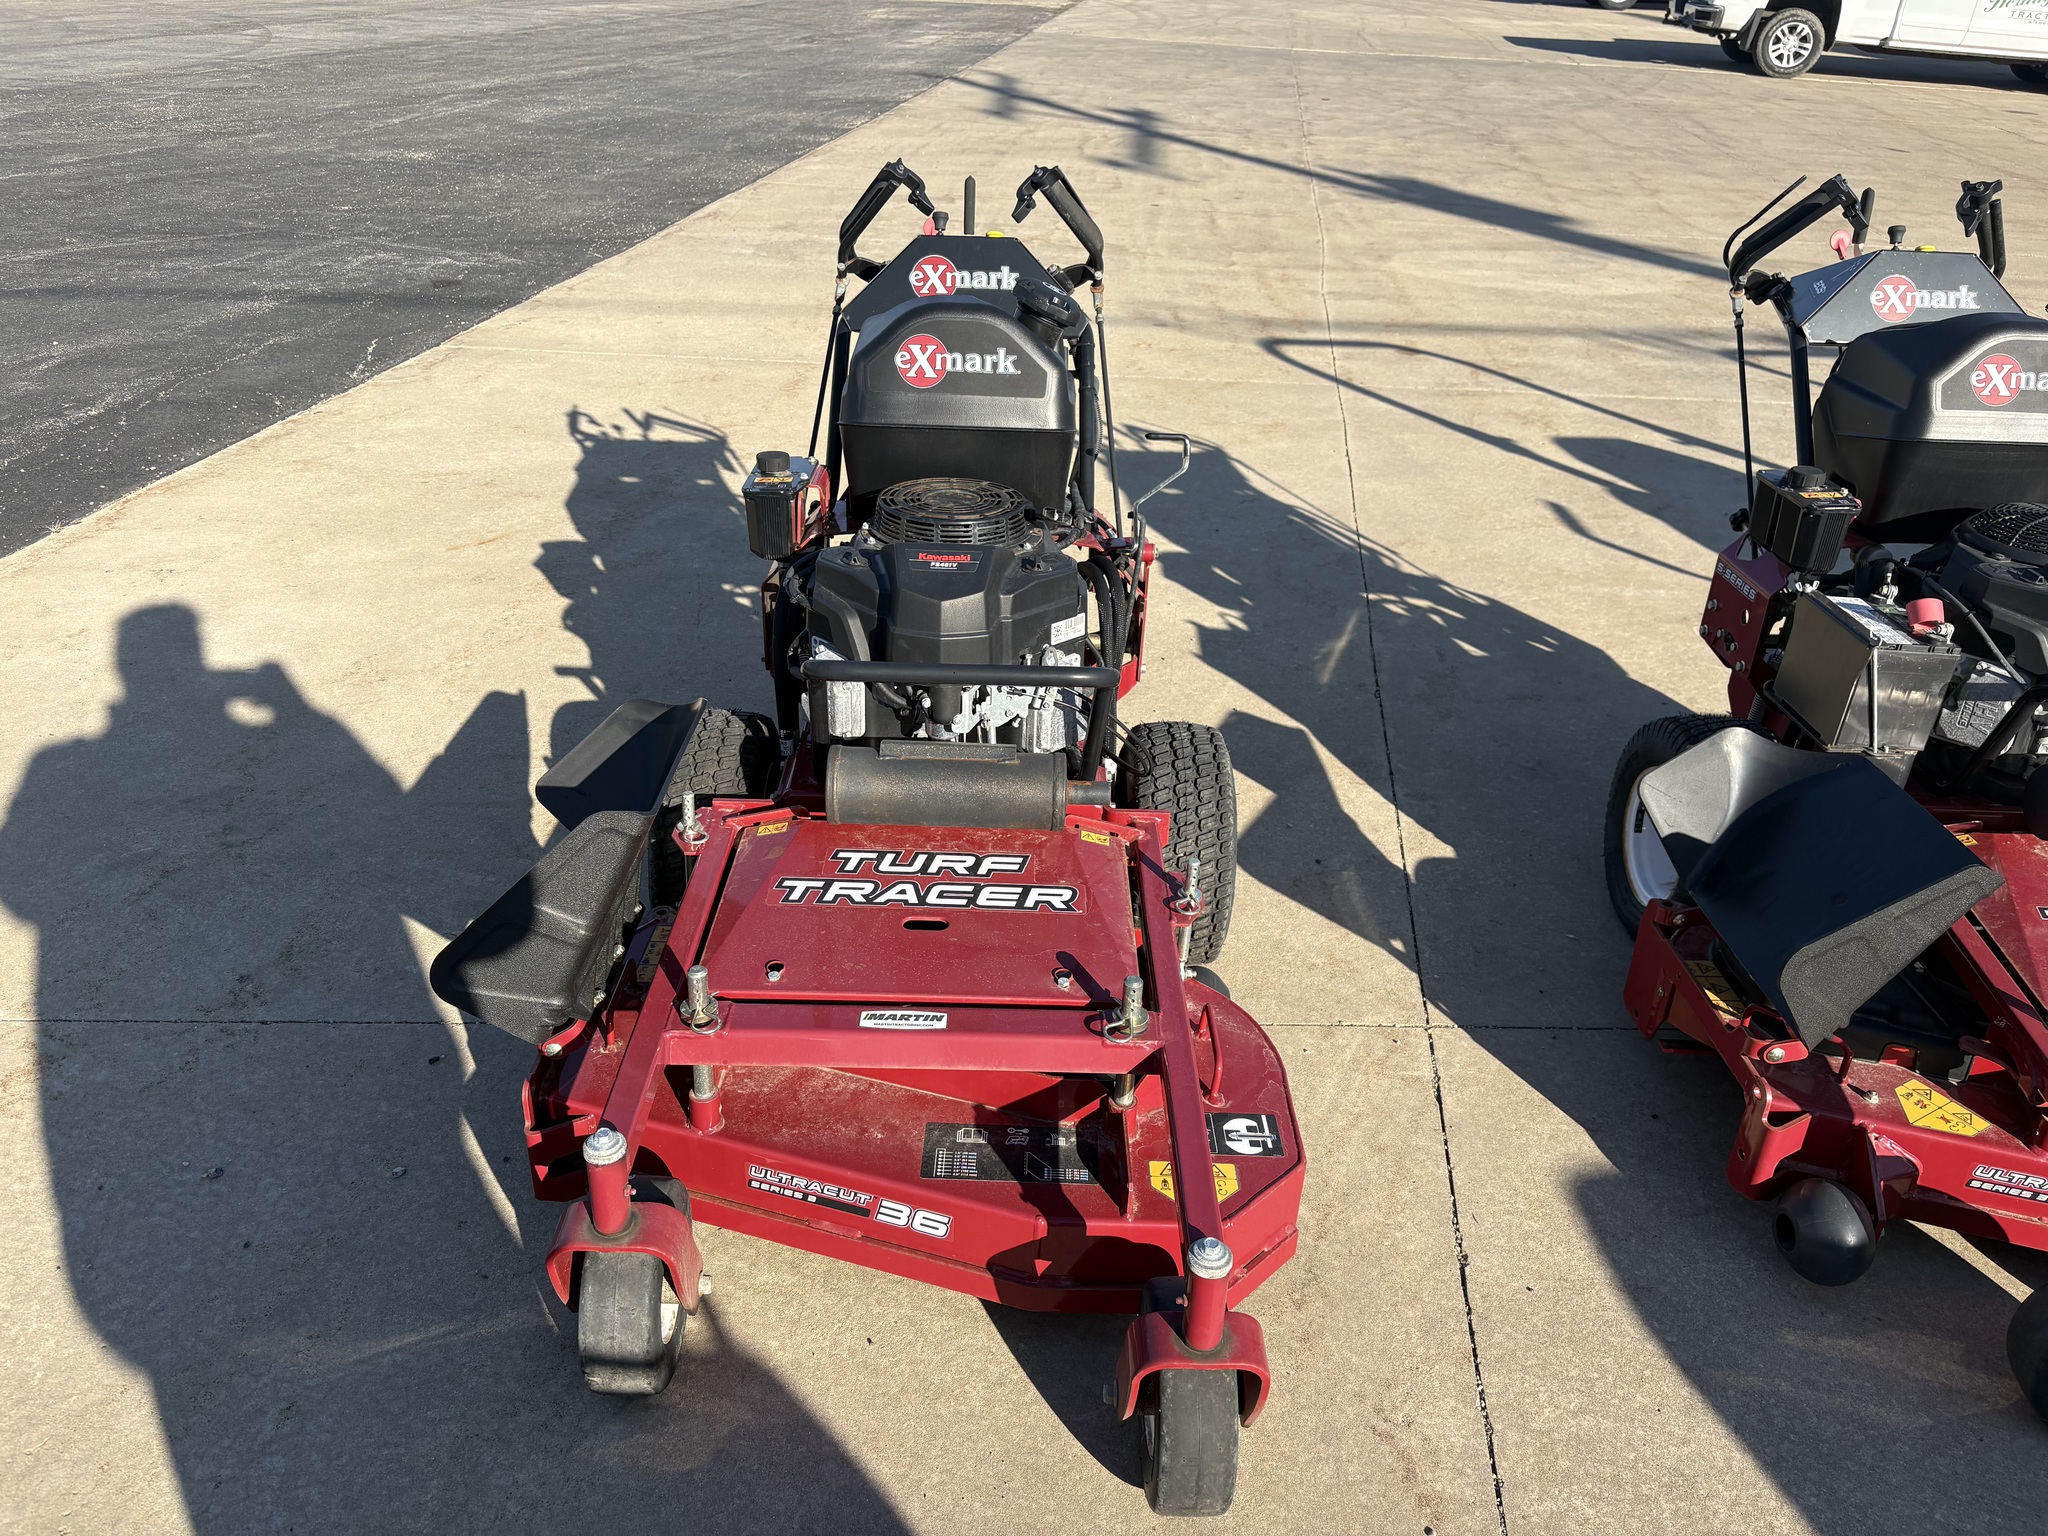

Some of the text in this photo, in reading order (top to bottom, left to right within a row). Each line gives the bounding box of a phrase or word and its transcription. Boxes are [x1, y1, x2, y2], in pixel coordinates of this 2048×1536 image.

[909, 264, 1020, 294] eXmark
[1870, 284, 1979, 314] eXmark
[894, 344, 1020, 378] eXmark
[918, 552, 971, 562] Kawasaki
[831, 850, 1029, 877] TURF
[775, 878, 1080, 912] TRACER
[863, 1013, 945, 1022] MARTIN
[749, 1166, 872, 1205] ULTRACUT
[750, 1180, 804, 1200] SERIES
[1969, 1180, 2033, 1198] SERIES
[1973, 1165, 2048, 1190] ULTR
[875, 1199, 953, 1238] 36
